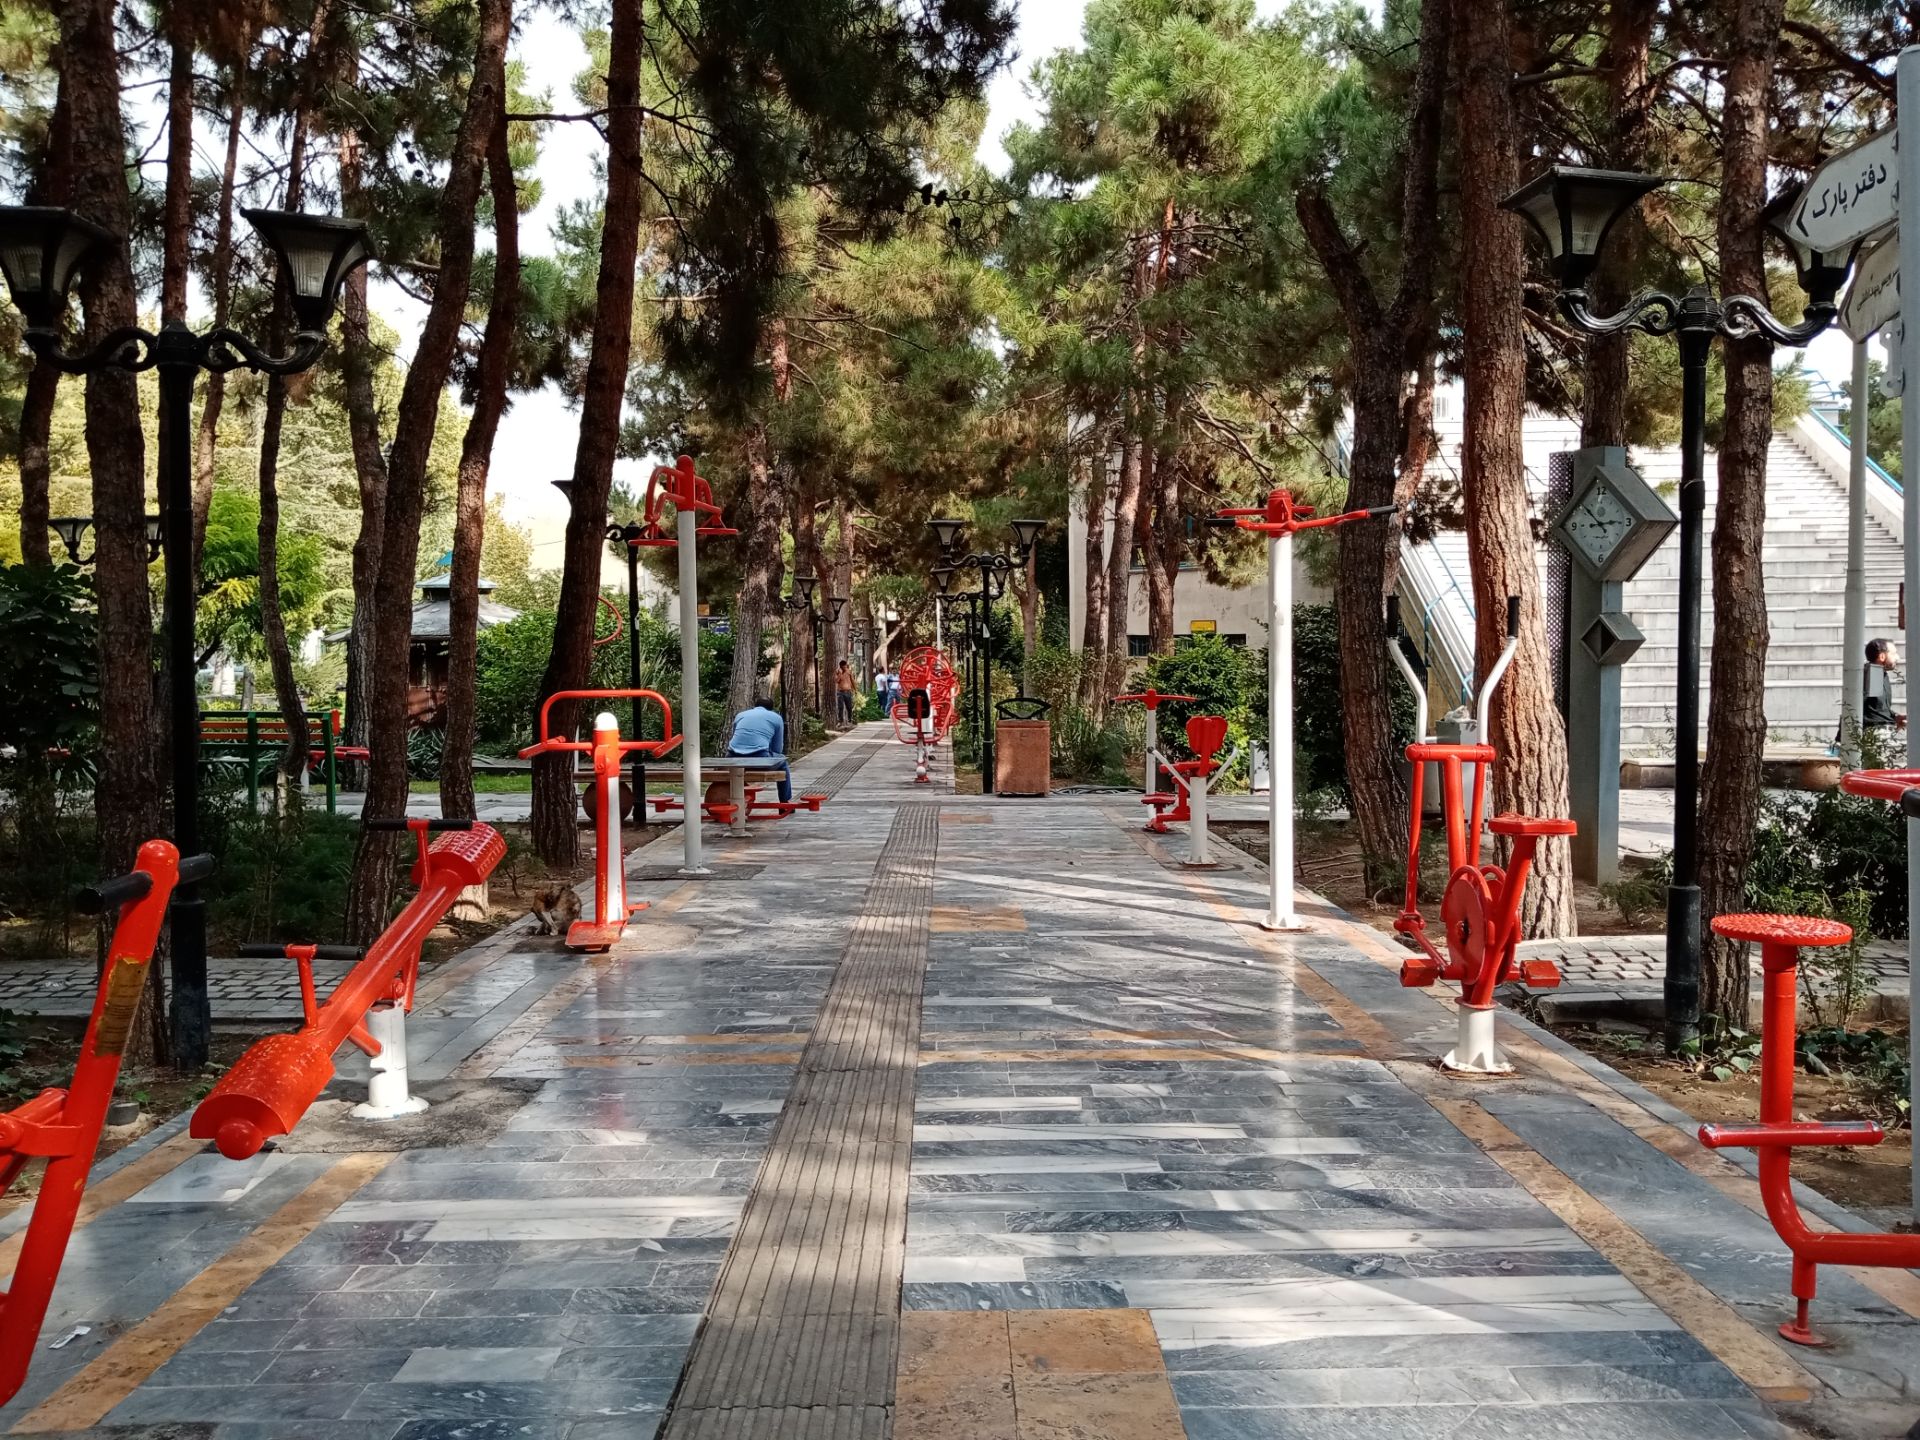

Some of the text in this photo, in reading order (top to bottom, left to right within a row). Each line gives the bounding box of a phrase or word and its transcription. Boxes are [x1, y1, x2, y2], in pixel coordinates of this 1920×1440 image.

[1812, 163, 1887, 219] دفتر پارک
[1596, 486, 1607, 496] 12
[1571, 522, 1577, 531] 9
[1625, 517, 1632, 527] 3
[1598, 553, 1604, 563] 6
